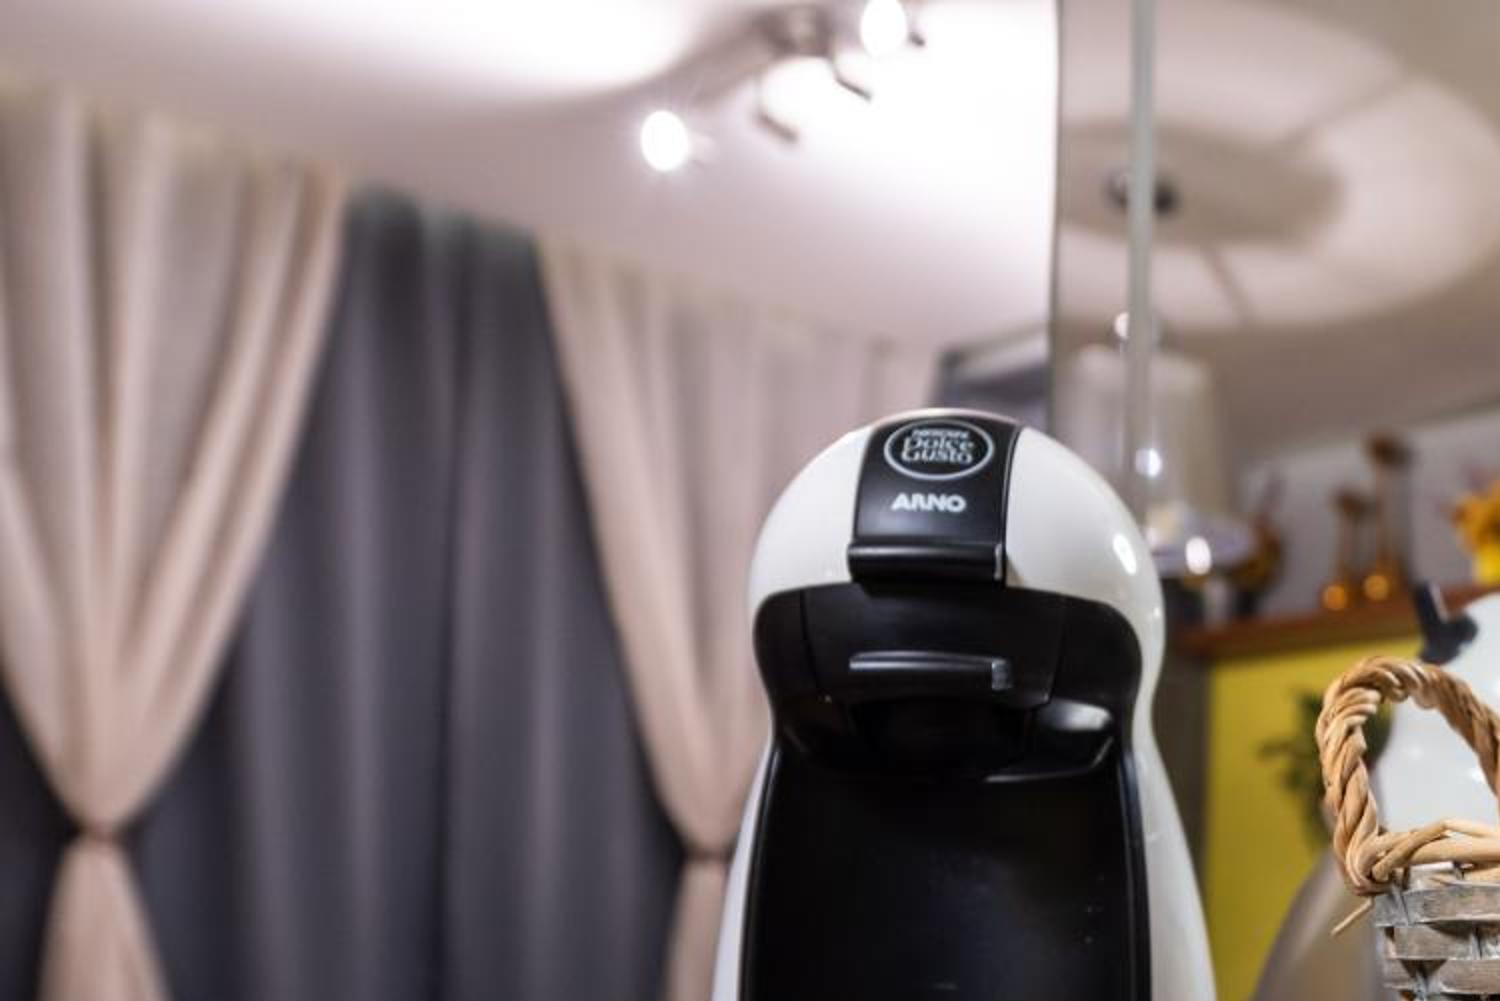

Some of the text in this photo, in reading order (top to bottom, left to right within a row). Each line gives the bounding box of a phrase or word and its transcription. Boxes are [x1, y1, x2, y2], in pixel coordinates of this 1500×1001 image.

[903, 436, 975, 450] Dolce
[901, 449, 973, 464] Gusto
[891, 493, 966, 512] ARNO
